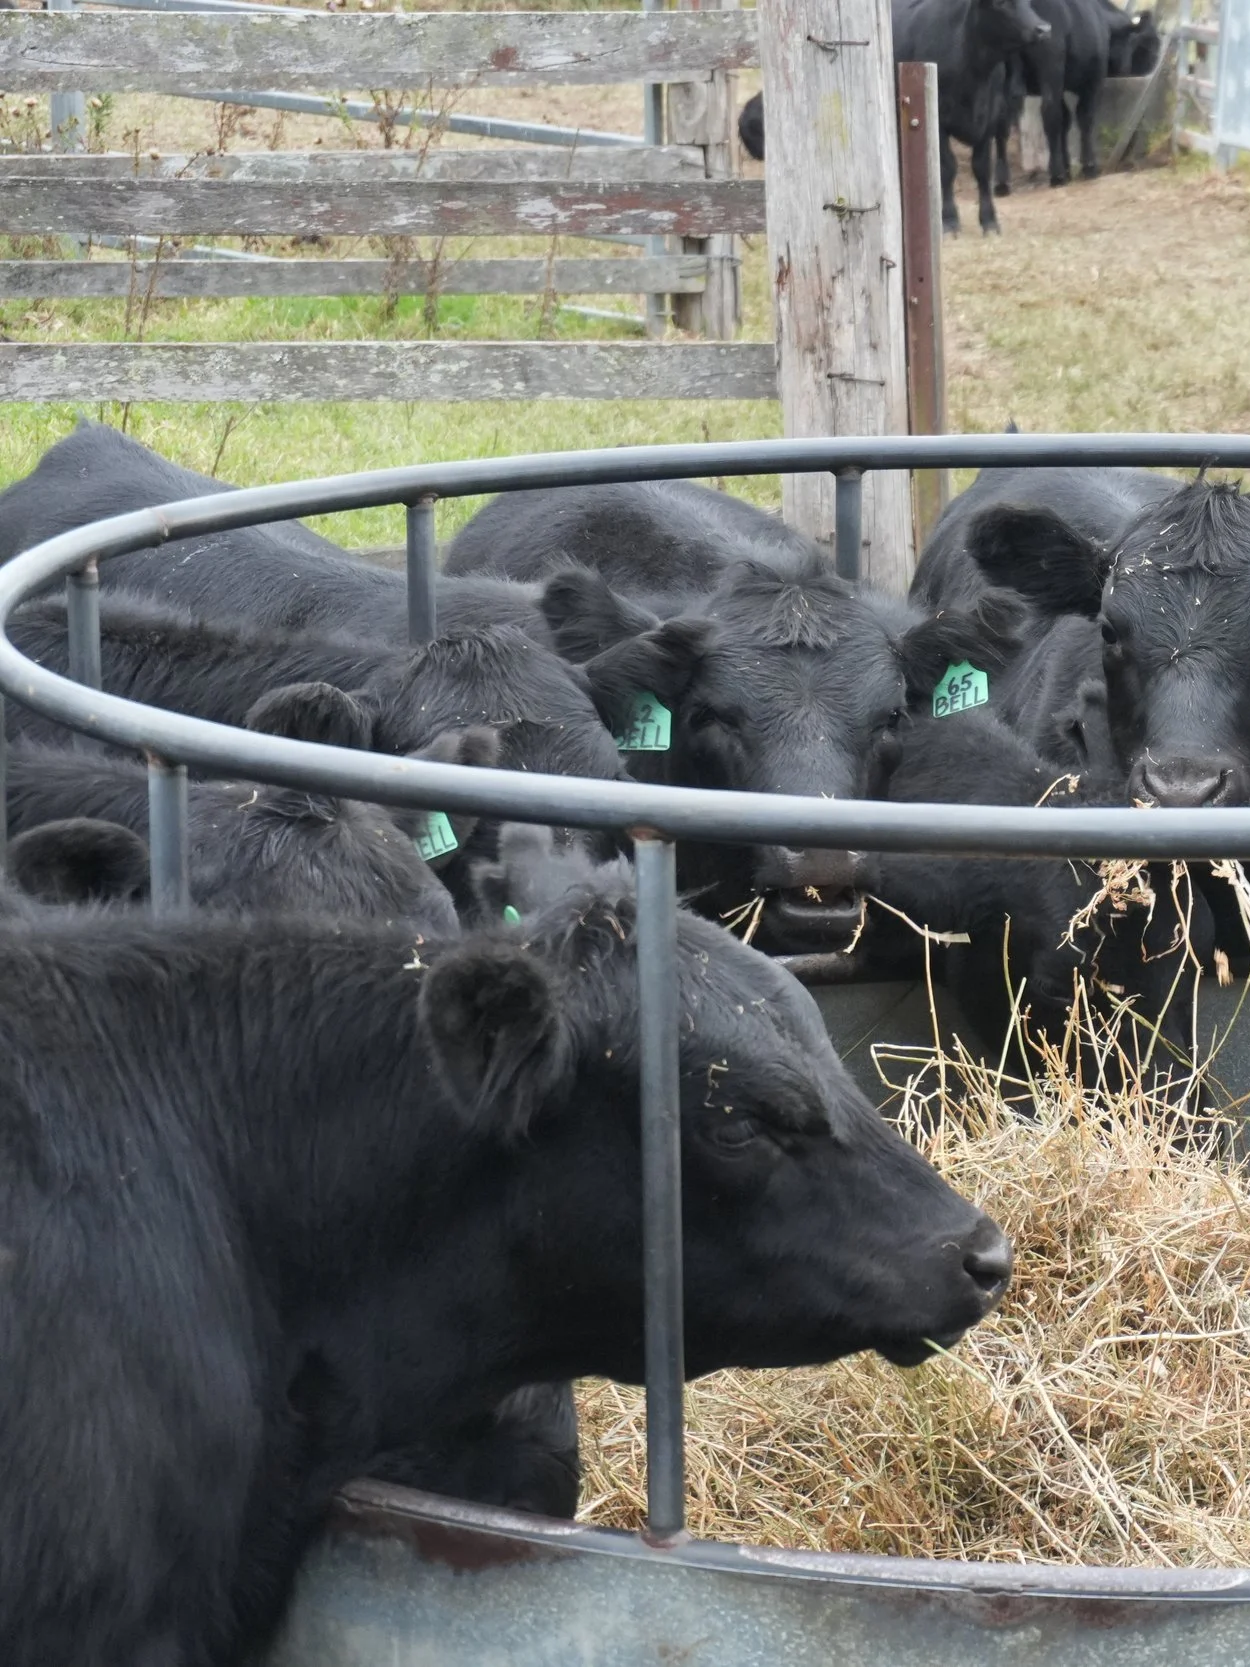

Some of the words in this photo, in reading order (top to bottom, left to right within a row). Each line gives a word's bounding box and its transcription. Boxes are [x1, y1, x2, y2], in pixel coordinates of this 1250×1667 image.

[948, 672, 974, 695] 65
[936, 686, 987, 717] BELL
[415, 825, 457, 859] ELL
